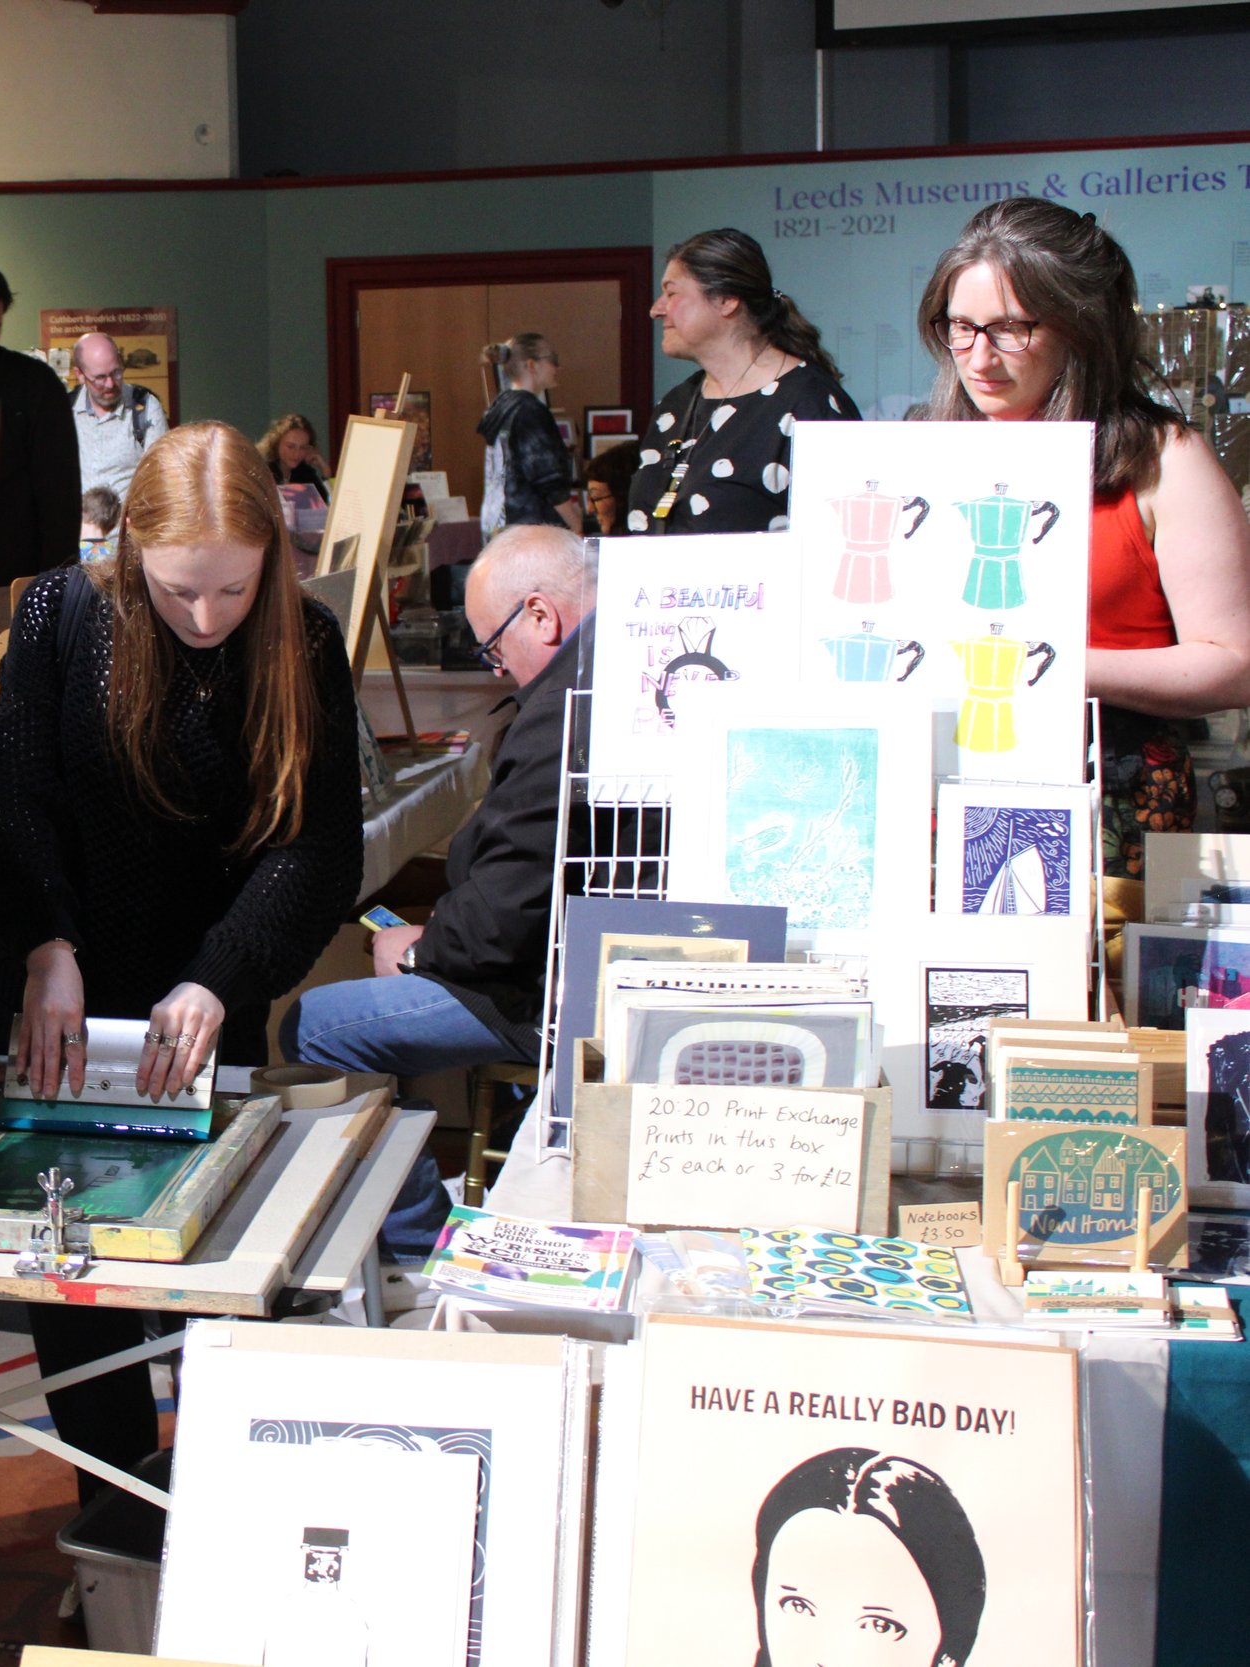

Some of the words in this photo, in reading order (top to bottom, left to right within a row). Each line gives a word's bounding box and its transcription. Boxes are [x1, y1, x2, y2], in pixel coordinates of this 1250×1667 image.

[774, 181, 864, 211] Leeds
[875, 173, 1031, 207] Museums
[1042, 173, 1067, 199] &
[1080, 165, 1227, 198] Galleries
[634, 586, 651, 607] A
[649, 1097, 710, 1117] 20:20
[725, 1100, 768, 1120] Print
[776, 1106, 859, 1136] Exchange
[645, 1125, 693, 1146] Prints
[708, 1132, 727, 1146] in
[737, 1129, 776, 1149] this
[789, 1135, 825, 1154] box
[638, 1150, 674, 1181] £5
[682, 1158, 727, 1174] each
[735, 1163, 755, 1175] or
[769, 1163, 784, 1180] 3
[791, 1166, 818, 1185] for
[820, 1167, 852, 1187] £12
[496, 1221, 539, 1234] LEEDS
[907, 1211, 978, 1224] Notebooks
[1030, 1213, 1076, 1235] New
[493, 1231, 571, 1248] WORKSHOP
[920, 1226, 965, 1244] £3.50
[690, 1385, 756, 1412] HAVE
[763, 1390, 780, 1415] A
[789, 1391, 885, 1423] REALLY
[892, 1399, 947, 1429] BAD
[955, 1405, 1016, 1436] DAY!
